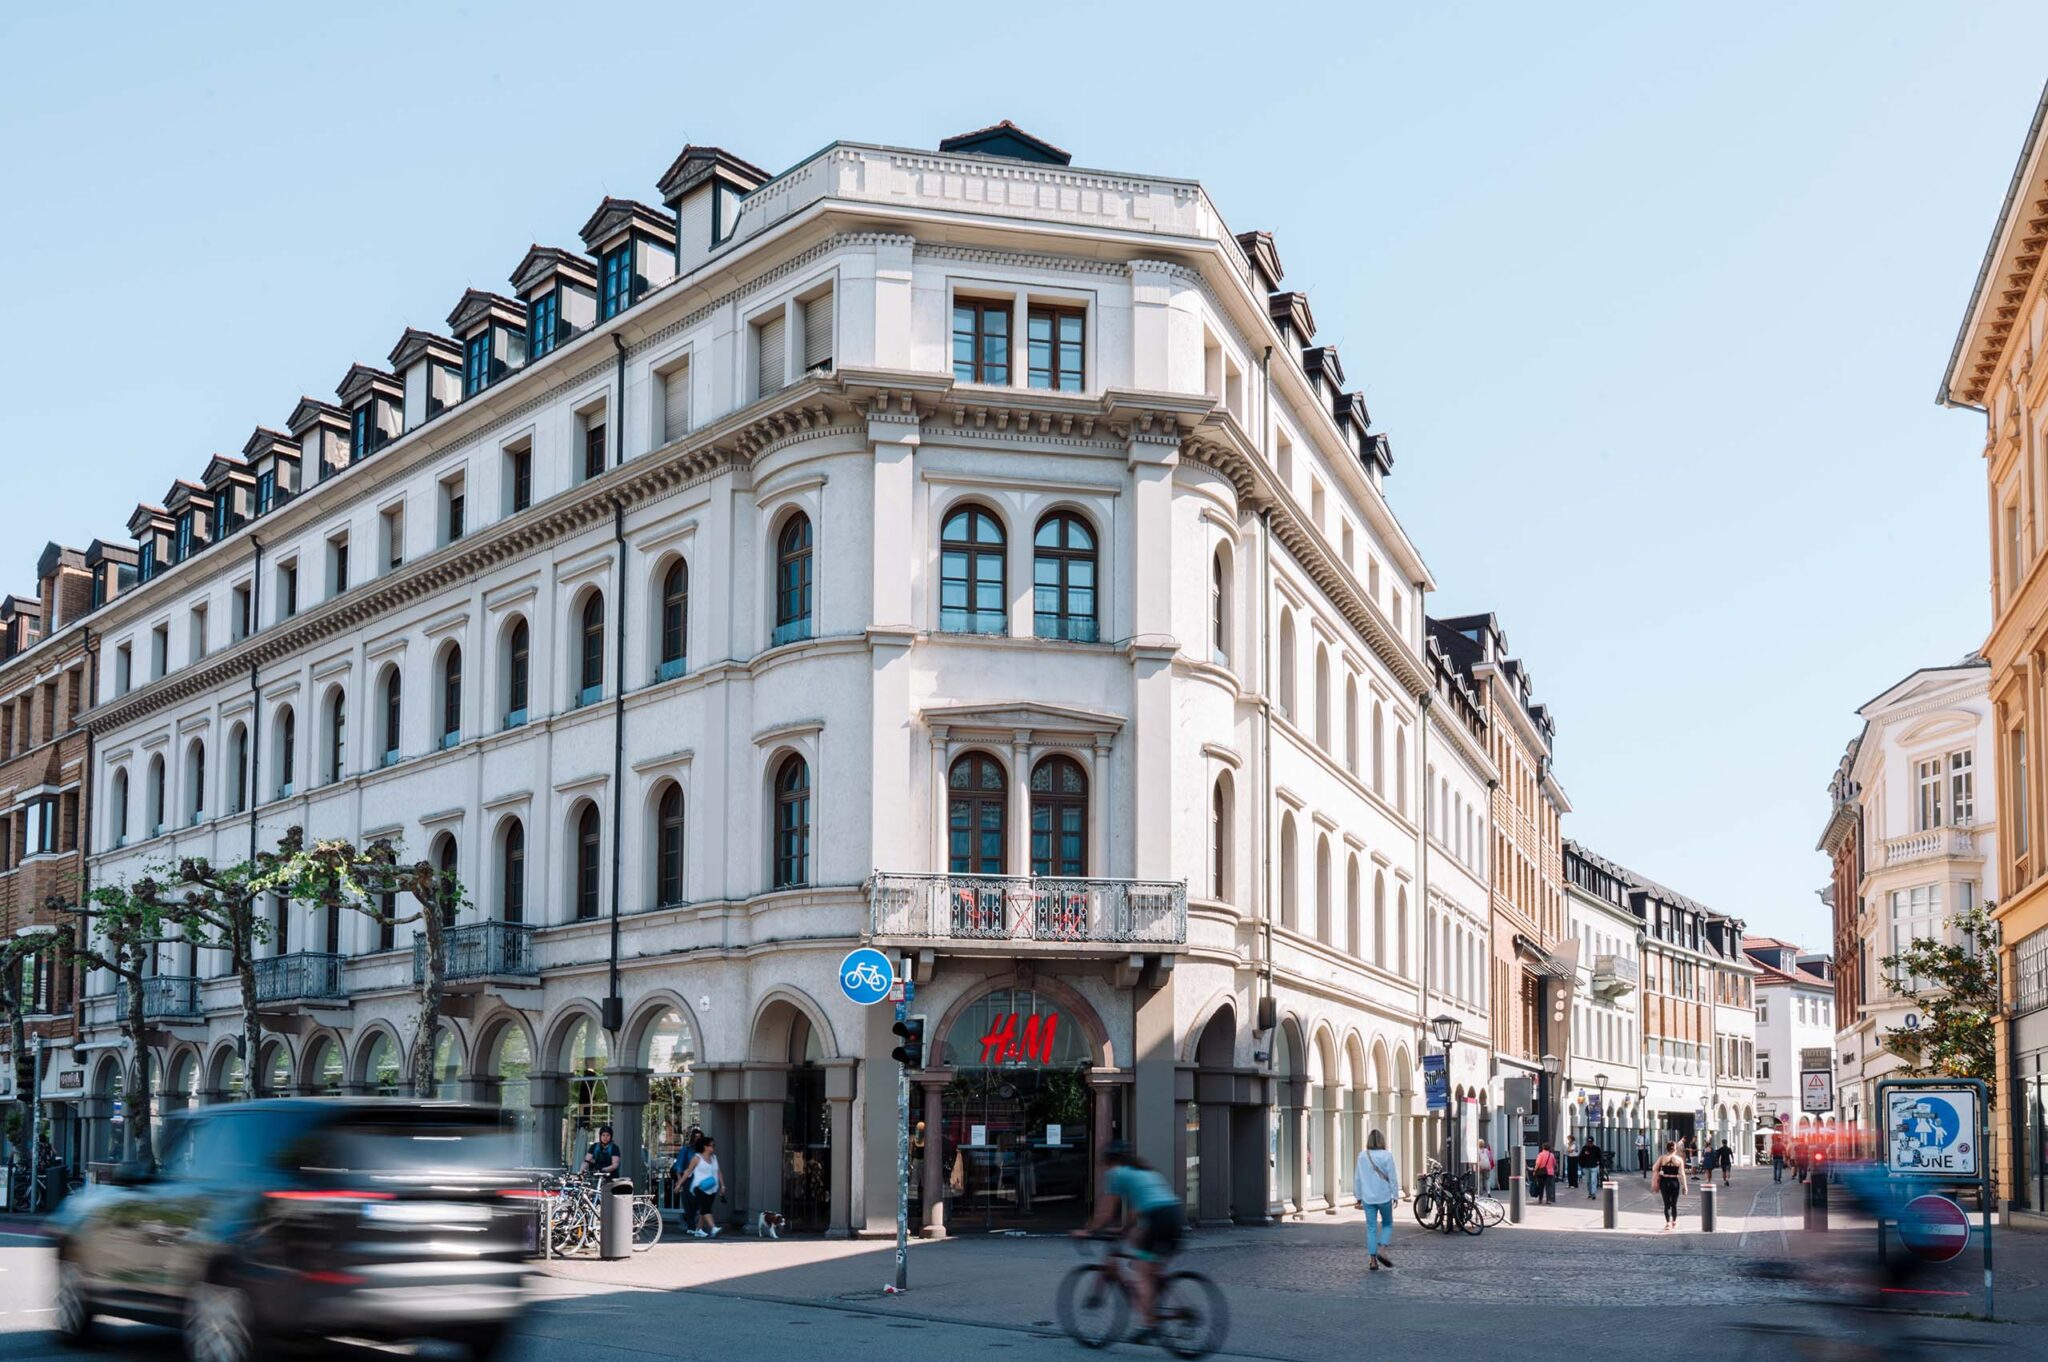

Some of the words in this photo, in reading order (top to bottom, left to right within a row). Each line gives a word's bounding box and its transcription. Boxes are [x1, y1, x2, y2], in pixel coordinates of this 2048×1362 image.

[980, 1011, 1058, 1066] H&M
[1803, 1049, 1829, 1057] HOTEL
[1911, 1155, 1954, 1169] ONE
